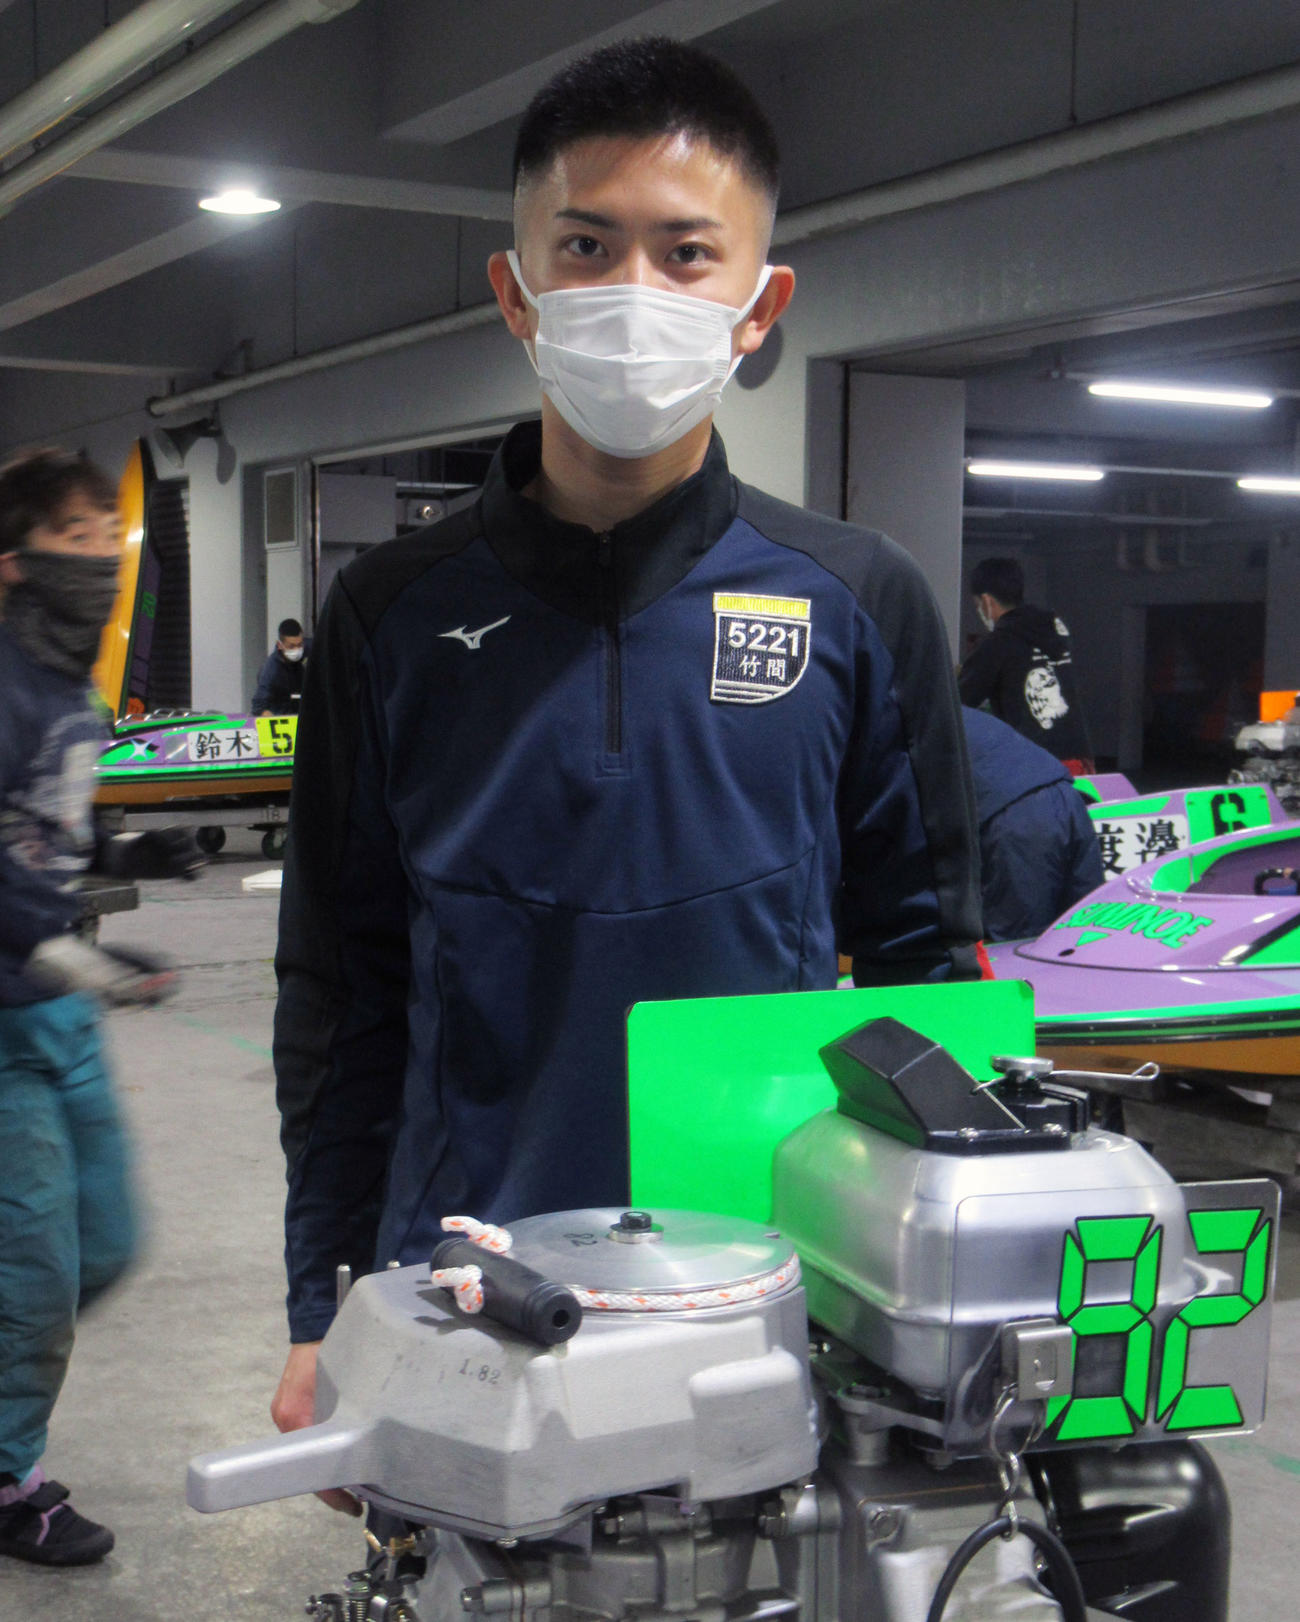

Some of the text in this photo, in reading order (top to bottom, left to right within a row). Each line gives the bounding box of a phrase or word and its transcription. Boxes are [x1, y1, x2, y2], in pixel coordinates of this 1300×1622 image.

[728, 621, 799, 657] 5221
[739, 655, 785, 681] 竹間
[196, 719, 293, 759] 鈴木 5
[1211, 792, 1247, 837] 6
[1045, 1207, 1273, 1442] 82
